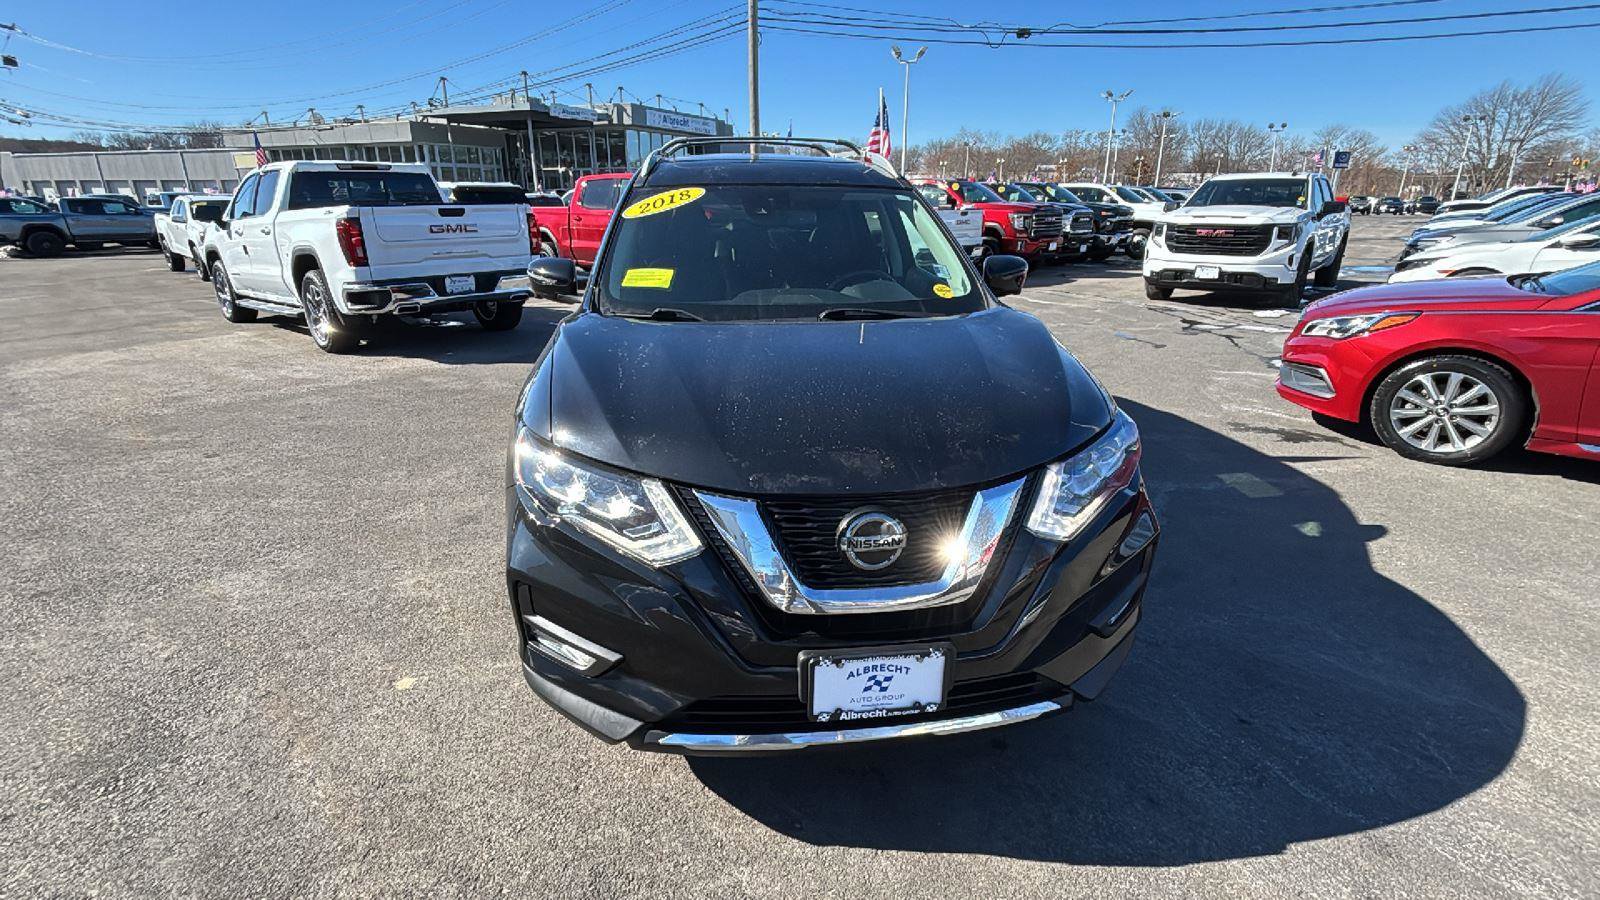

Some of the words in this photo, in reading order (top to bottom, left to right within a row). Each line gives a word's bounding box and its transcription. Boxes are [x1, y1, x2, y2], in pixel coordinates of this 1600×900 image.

[662, 114, 690, 127] Albrecht
[639, 190, 691, 214] 2018
[429, 223, 479, 234] GMC
[847, 537, 903, 549] NISSAN
[846, 664, 911, 680] ALBRECHT
[875, 693, 905, 701] GROUP
[840, 709, 888, 720] Albrecht
